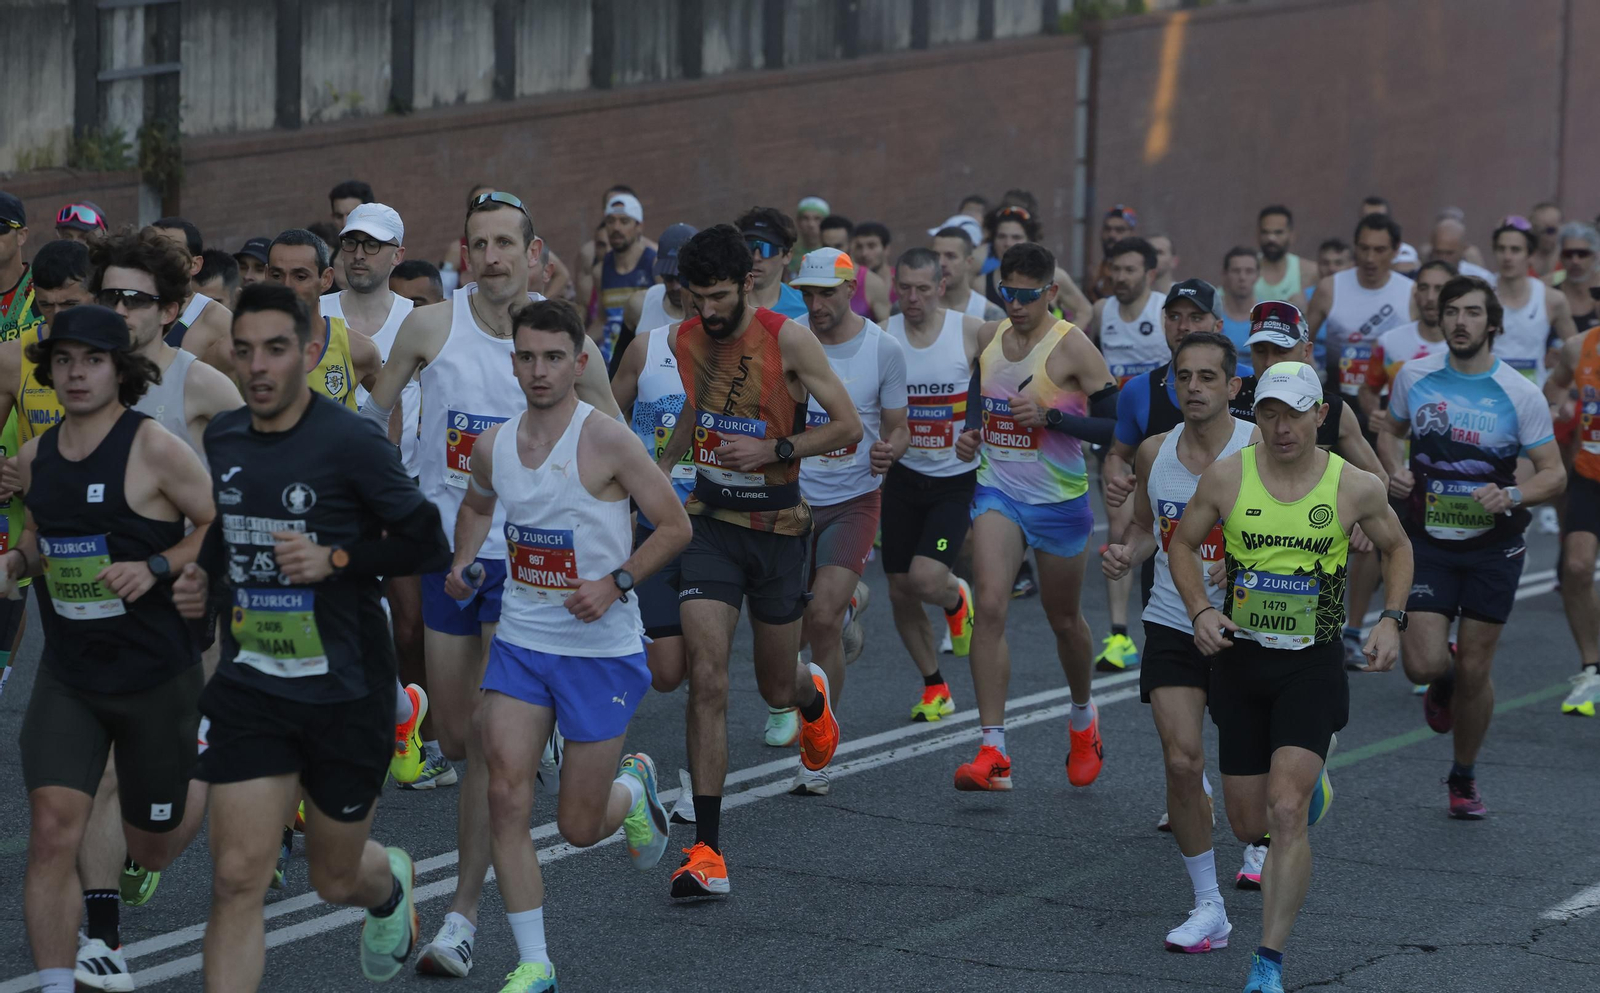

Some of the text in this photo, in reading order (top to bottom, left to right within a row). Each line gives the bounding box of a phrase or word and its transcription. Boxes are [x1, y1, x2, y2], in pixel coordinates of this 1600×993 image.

[718, 419, 757, 433] ZURICH
[996, 421, 1014, 430] 1203
[986, 431, 1031, 448] LORENZO
[1451, 428, 1481, 445] TRAIL
[736, 490, 769, 499] LURBEL
[523, 532, 563, 545] ZURICH
[1241, 530, 1334, 555] DEPORTEMANIA
[52, 541, 97, 554] ZURICH
[529, 554, 544, 565] 897
[60, 566, 82, 577] 2013
[518, 565, 568, 587] AURYAN
[55, 582, 103, 599] PIERRE
[1262, 577, 1310, 591] ZURICH
[251, 595, 302, 607] ZURICH
[1262, 600, 1287, 612] 1479
[1249, 612, 1297, 632] DAVID
